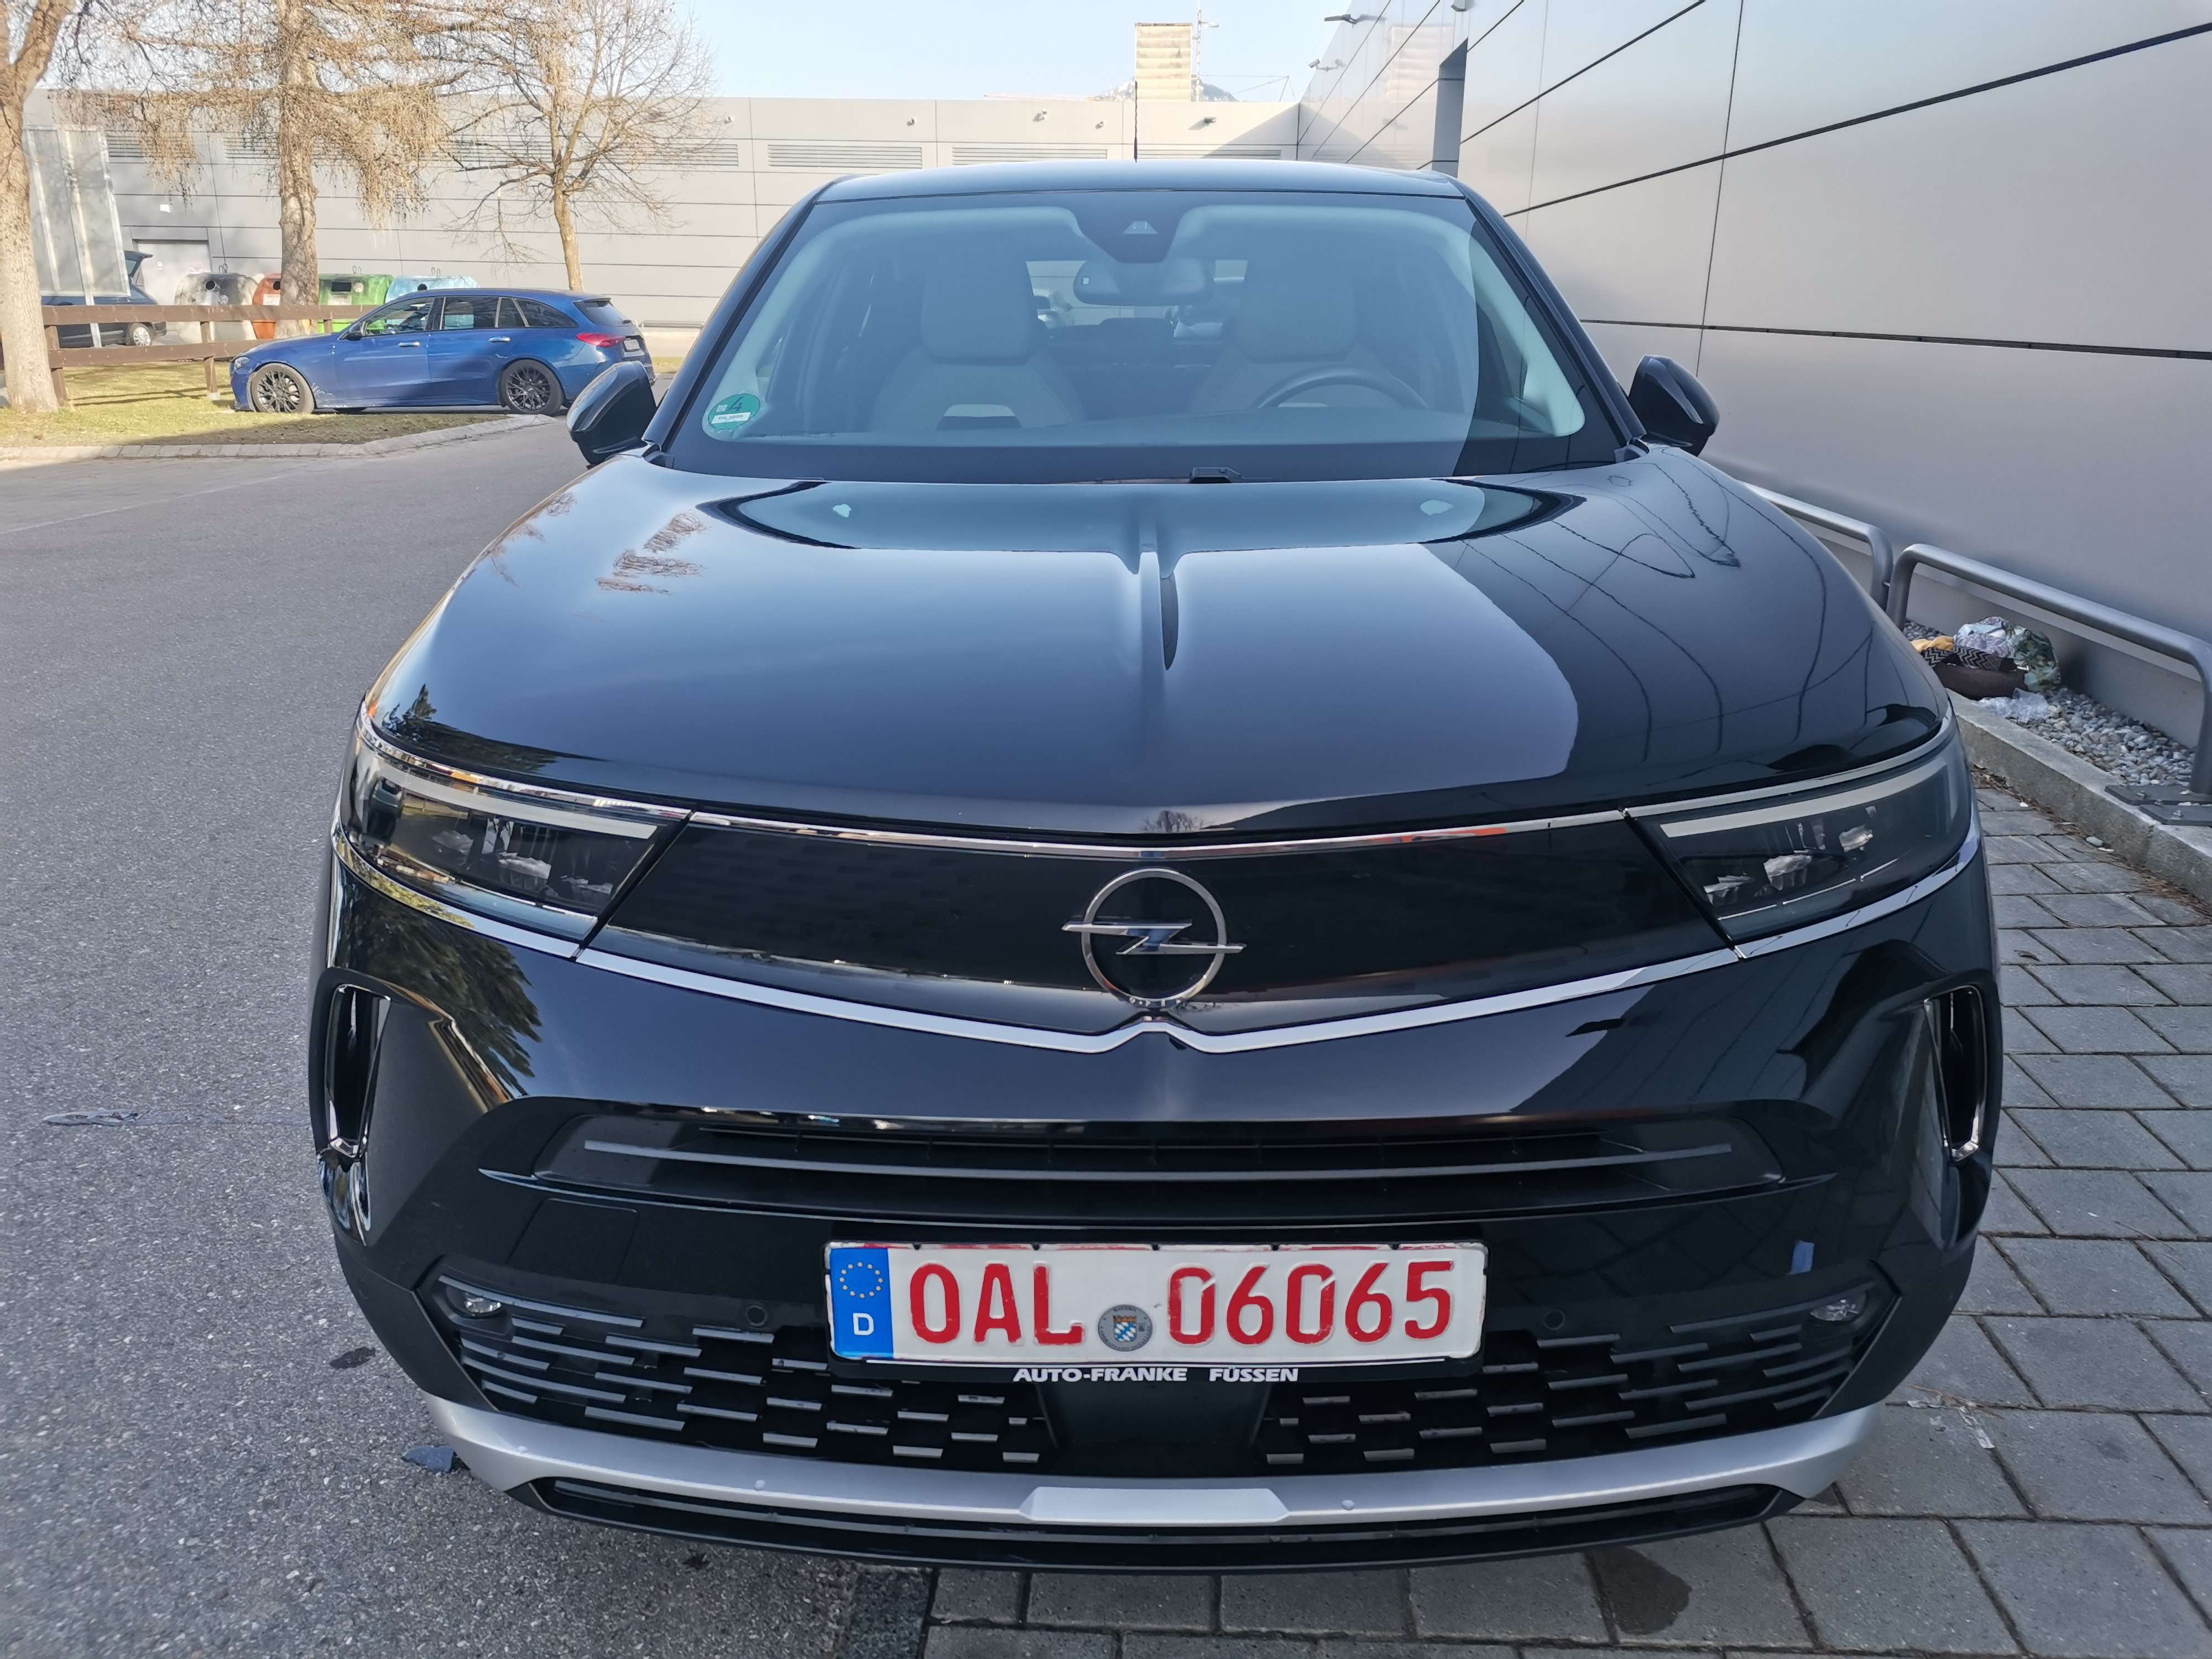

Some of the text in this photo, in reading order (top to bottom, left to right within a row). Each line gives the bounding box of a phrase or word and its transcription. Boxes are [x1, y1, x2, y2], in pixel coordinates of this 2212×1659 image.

[728, 396, 743, 411] 4
[910, 1260, 1453, 1345] OAL 06065
[853, 1313, 874, 1335] D
[1013, 1367, 1298, 1382] AUTO-FRANKE FÜSSEN
